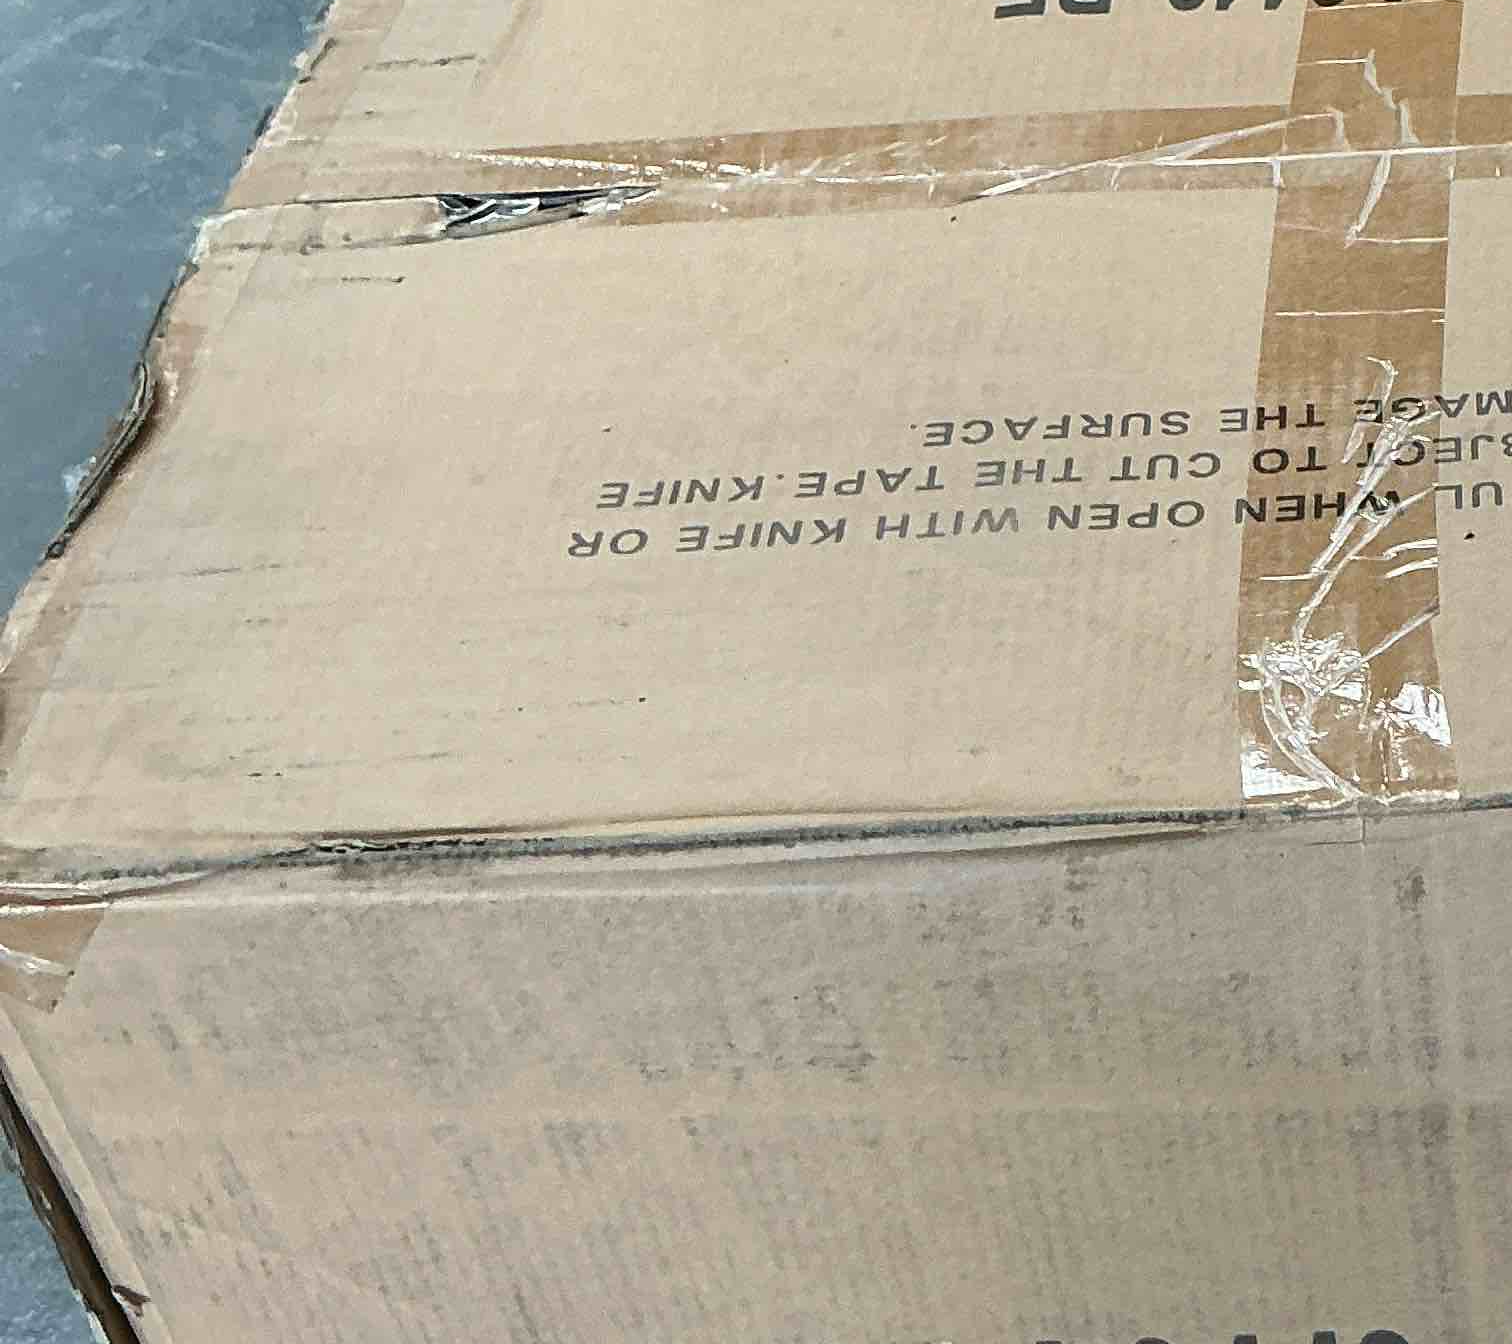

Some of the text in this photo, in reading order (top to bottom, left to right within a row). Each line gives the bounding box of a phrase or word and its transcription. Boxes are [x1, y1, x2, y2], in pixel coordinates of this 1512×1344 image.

[908, 410, 1191, 447] SURFACE.
[1219, 398, 1327, 429] THE
[975, 459, 1089, 492] THE
[1107, 451, 1222, 484] CUT
[1254, 446, 1330, 474] TO
[875, 504, 1018, 541] WITH
[1047, 498, 1207, 533] OPEN
[1238, 487, 1406, 528] WHEN
[567, 525, 649, 559] OR
[675, 515, 849, 553] KNIFE
